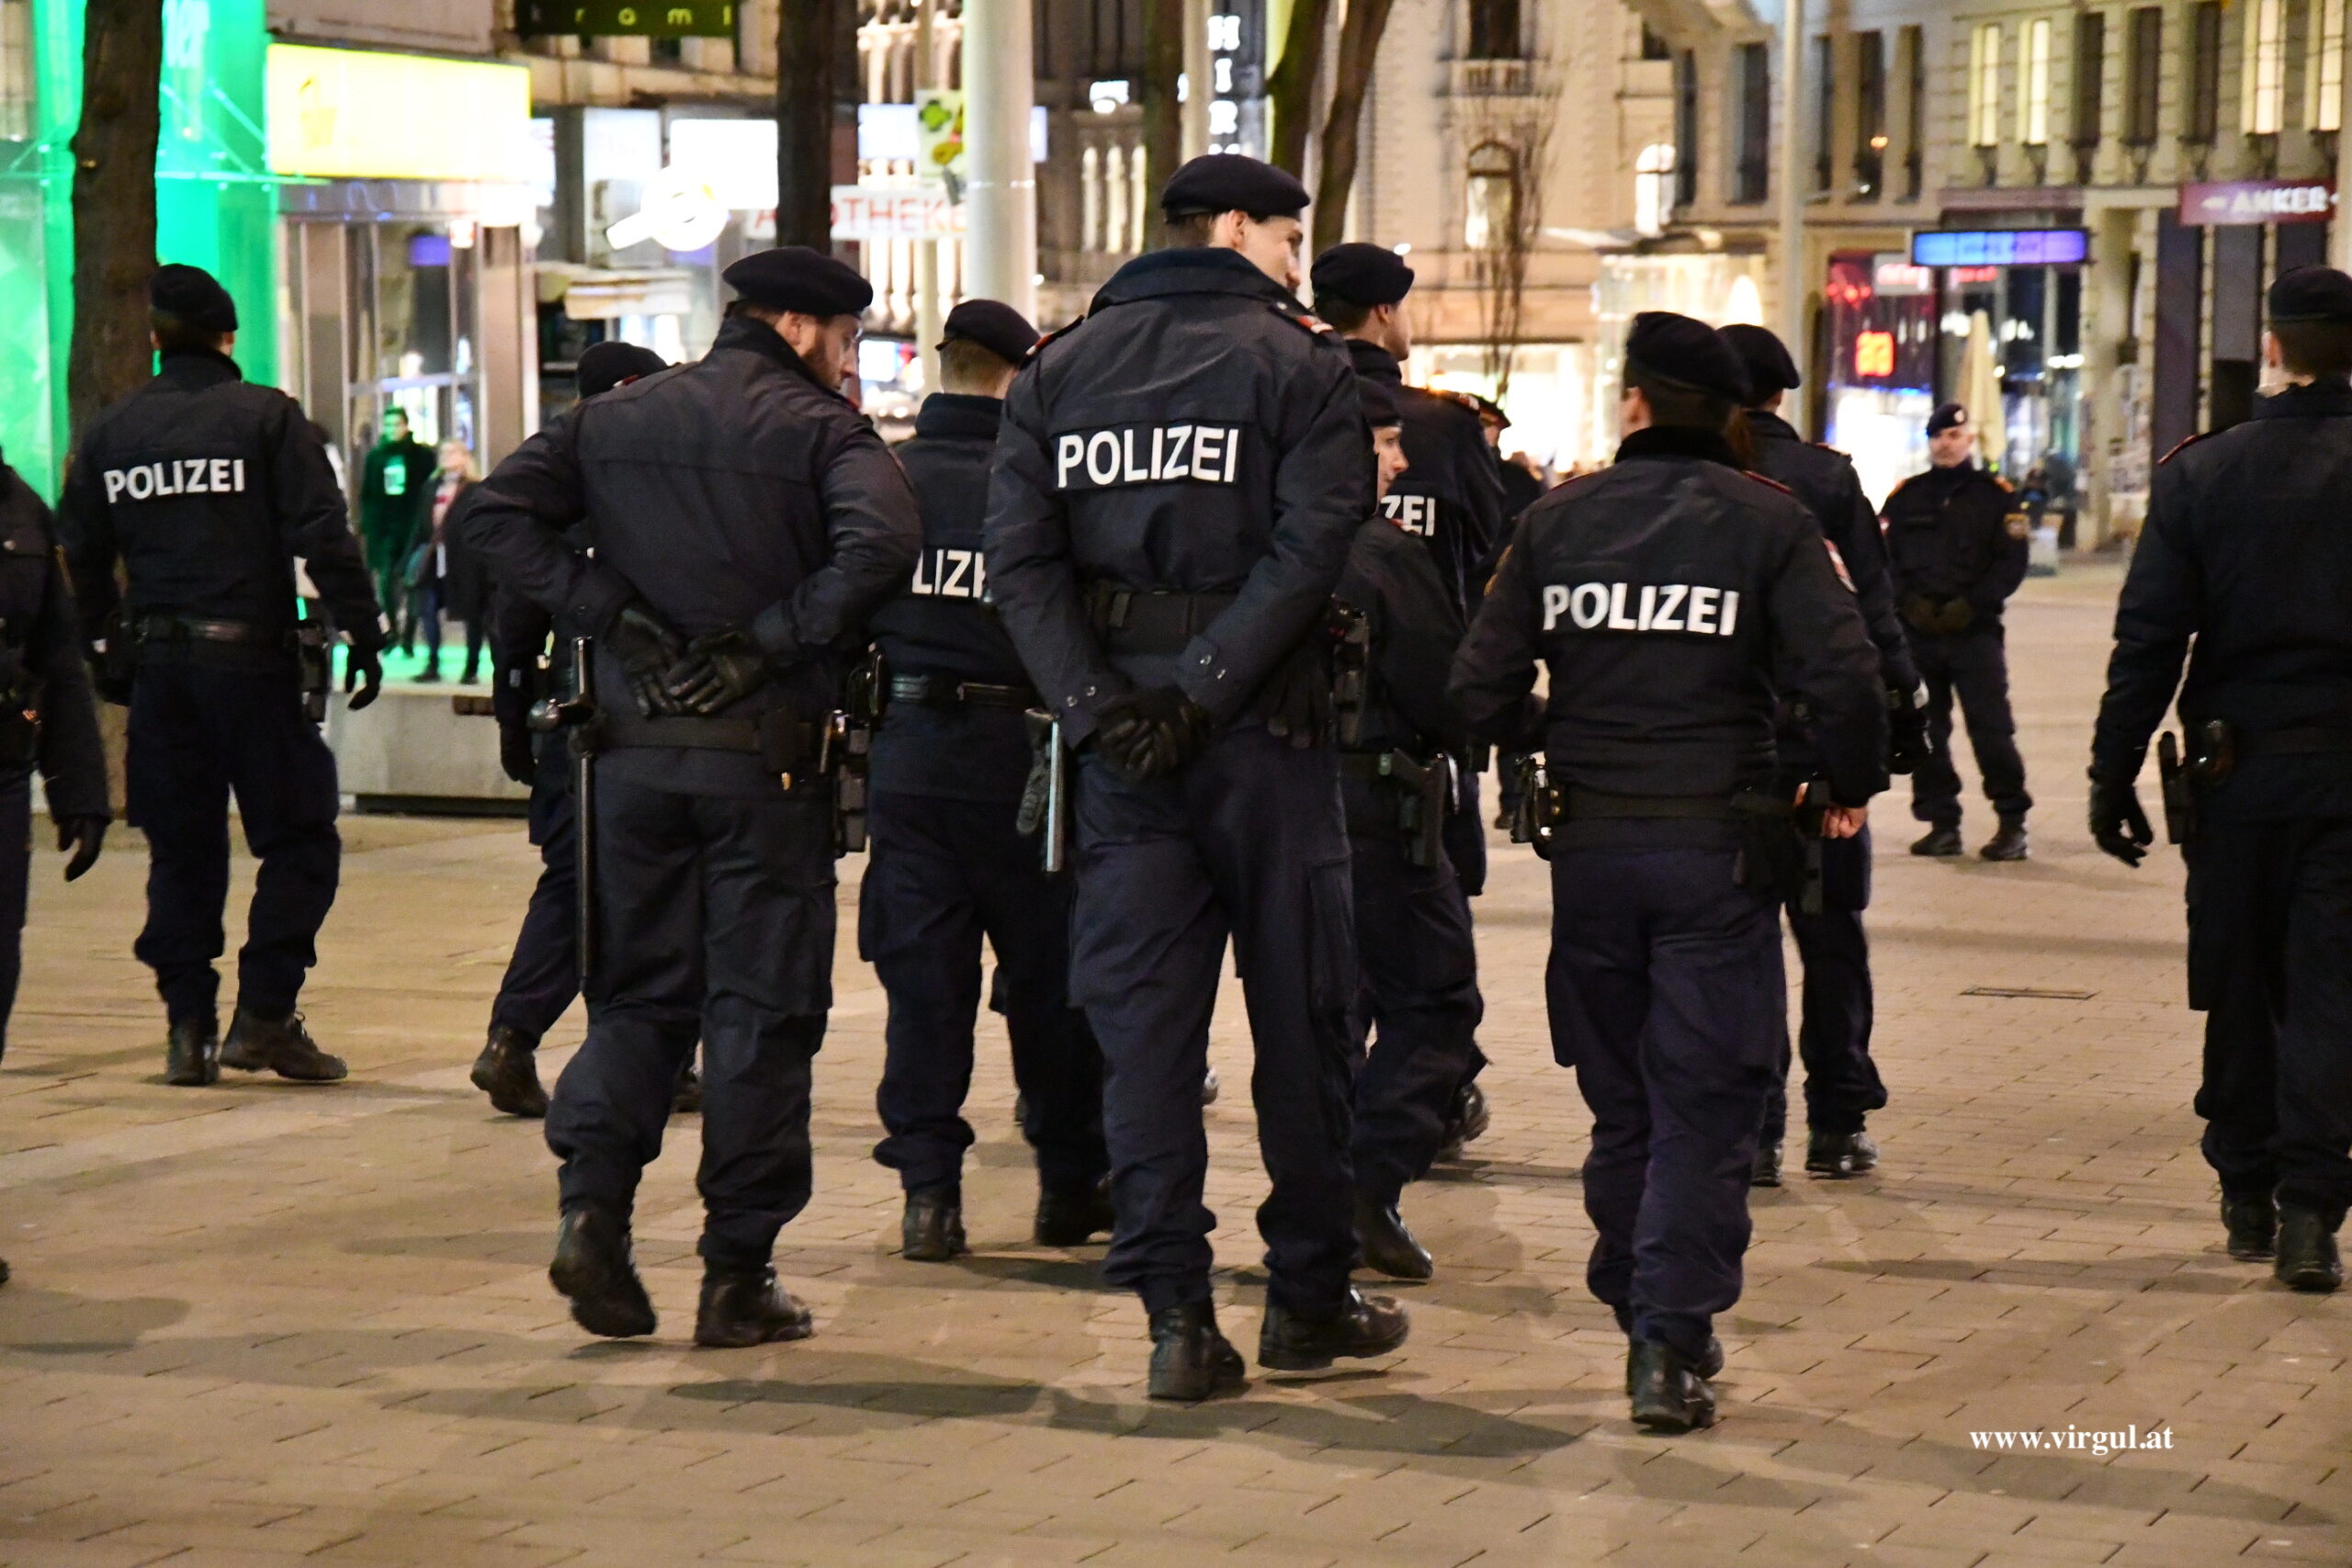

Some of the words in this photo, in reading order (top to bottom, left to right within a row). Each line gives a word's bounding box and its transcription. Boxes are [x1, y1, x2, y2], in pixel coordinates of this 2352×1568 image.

[1206, 14, 1241, 155] HIR
[103, 458, 245, 503] POLIZEI
[1057, 424, 1239, 489] POLIZEI
[1542, 581, 1740, 636] POLIZEI
